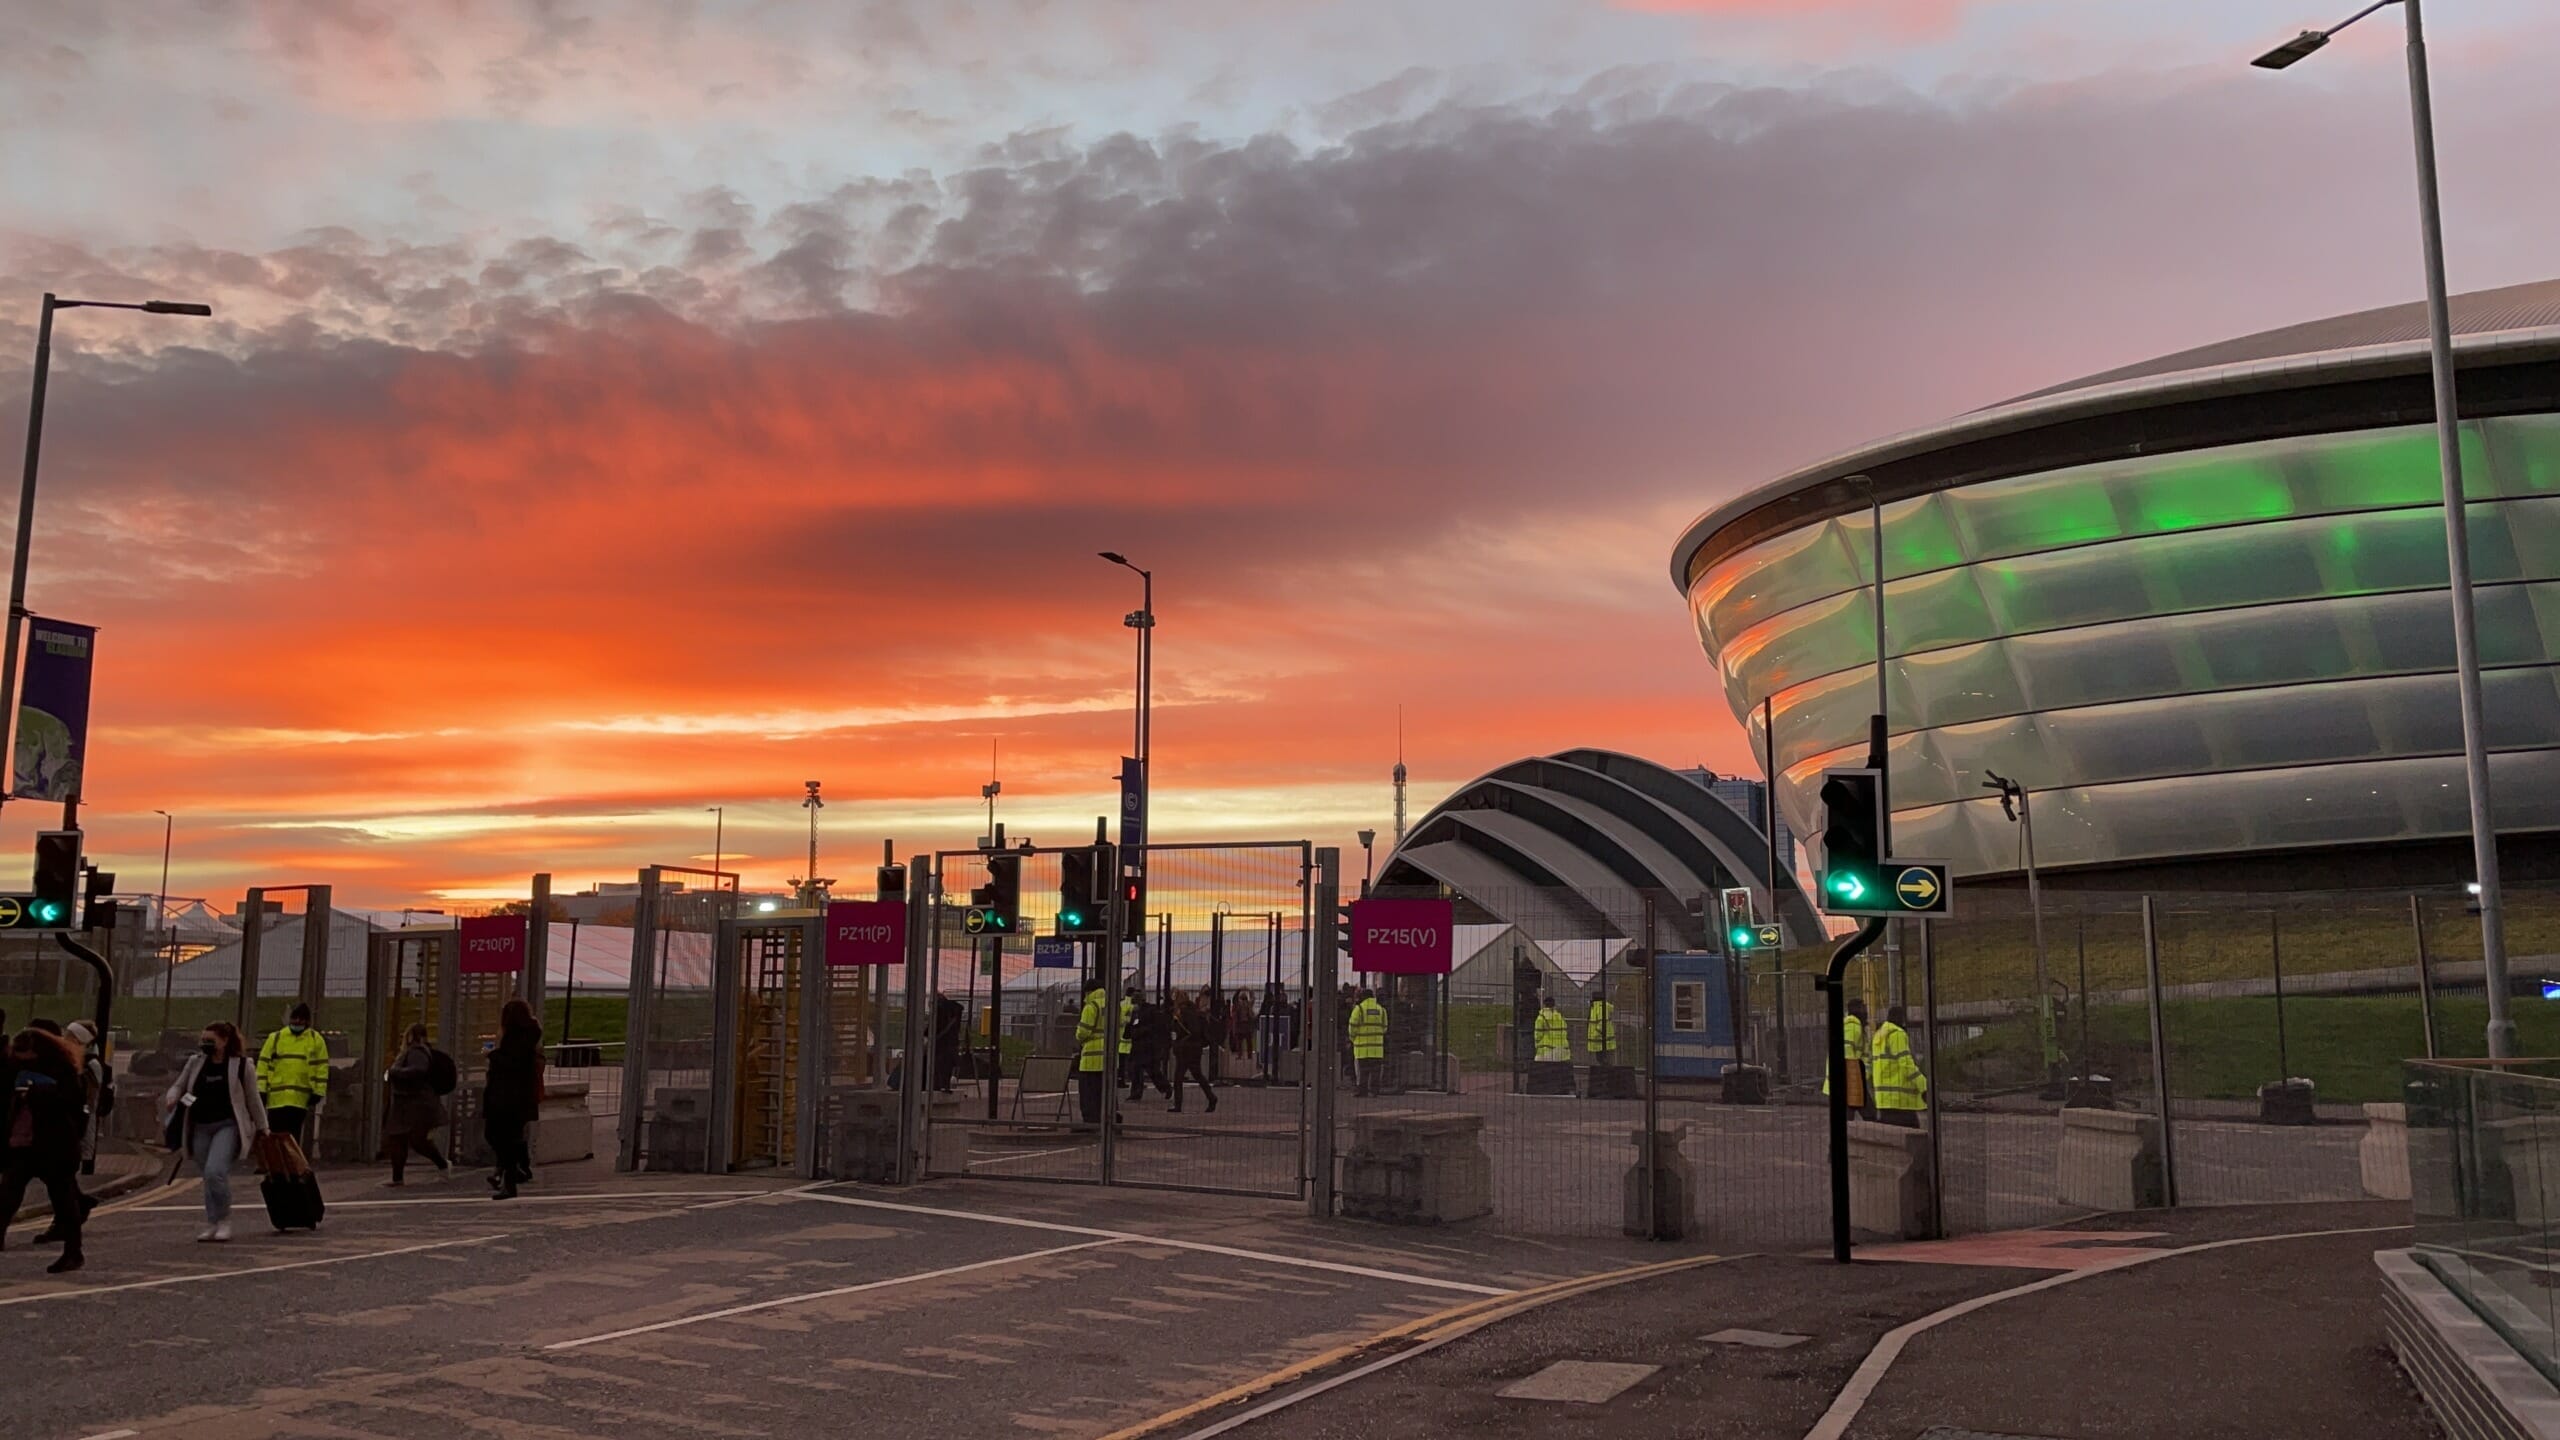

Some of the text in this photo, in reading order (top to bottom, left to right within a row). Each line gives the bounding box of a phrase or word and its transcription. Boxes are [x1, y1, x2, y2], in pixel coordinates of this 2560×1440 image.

[839, 925, 892, 943] PZ11(P)
[1367, 927, 1437, 948] PZ15(V)
[469, 937, 515, 953] PZ10(P)
